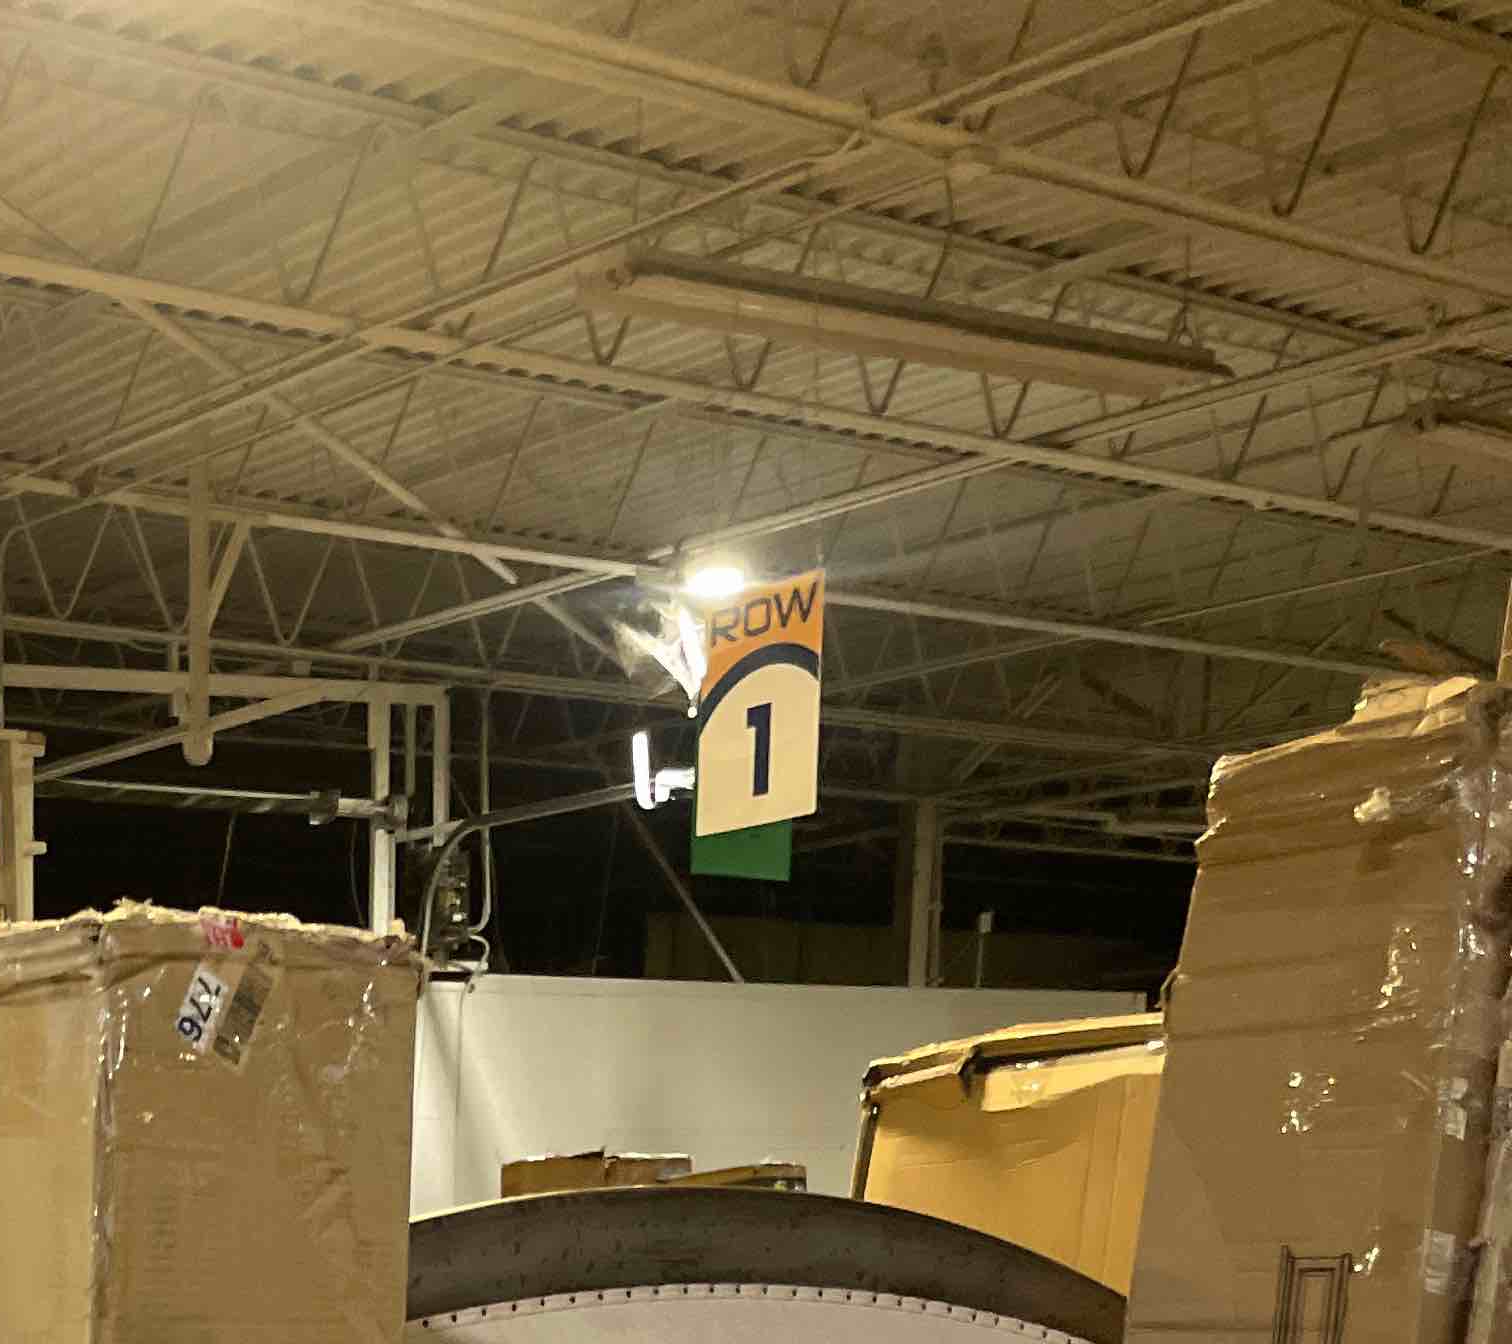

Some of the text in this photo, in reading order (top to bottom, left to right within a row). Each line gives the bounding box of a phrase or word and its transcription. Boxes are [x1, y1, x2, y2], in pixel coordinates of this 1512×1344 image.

[712, 583, 818, 646] ROW
[747, 703, 772, 797] 1
[178, 977, 221, 1042] 776
